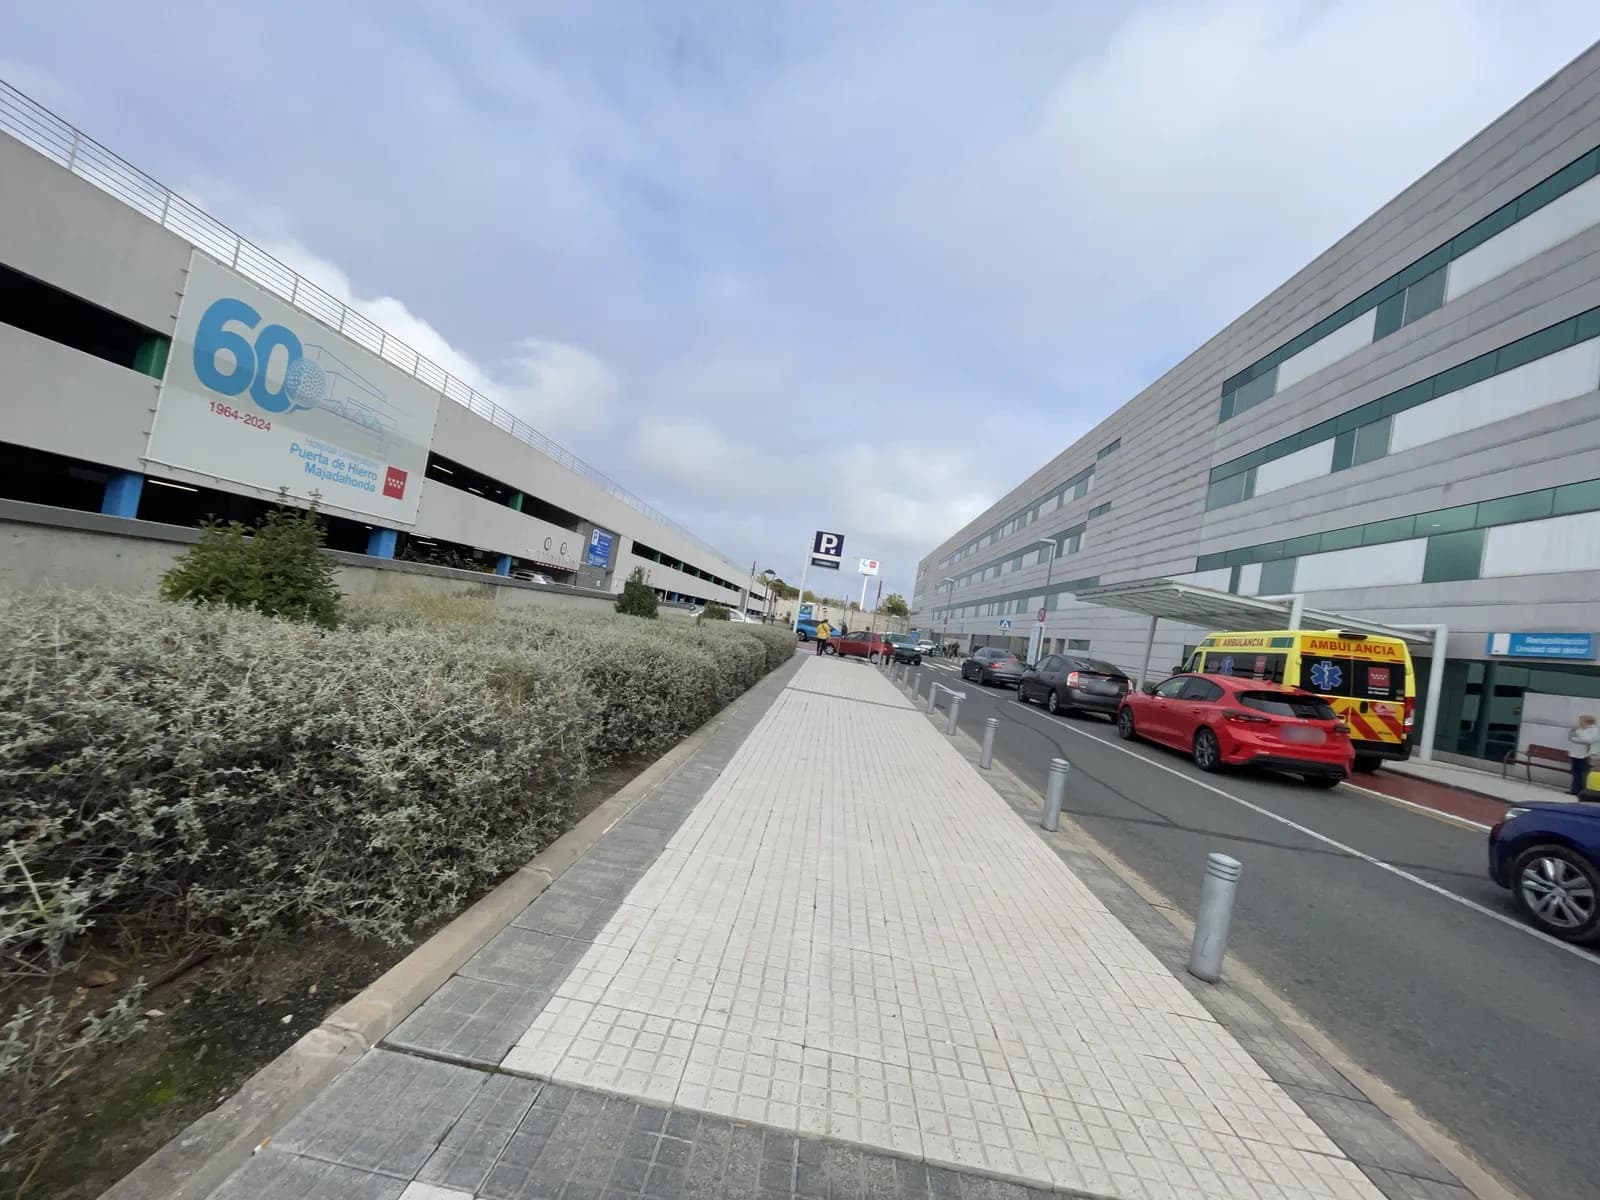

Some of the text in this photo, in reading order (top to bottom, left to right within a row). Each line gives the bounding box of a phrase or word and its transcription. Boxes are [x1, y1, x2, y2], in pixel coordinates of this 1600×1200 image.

[193, 298, 304, 413] 60
[209, 401, 272, 431] 1964-2024
[289, 442, 378, 481] Puerta de Hierro
[304, 461, 376, 493] Majadahonda
[820, 533, 838, 553] P
[1222, 637, 1264, 648] AMBULANCIA
[1310, 639, 1396, 656] AMBULANCIA
